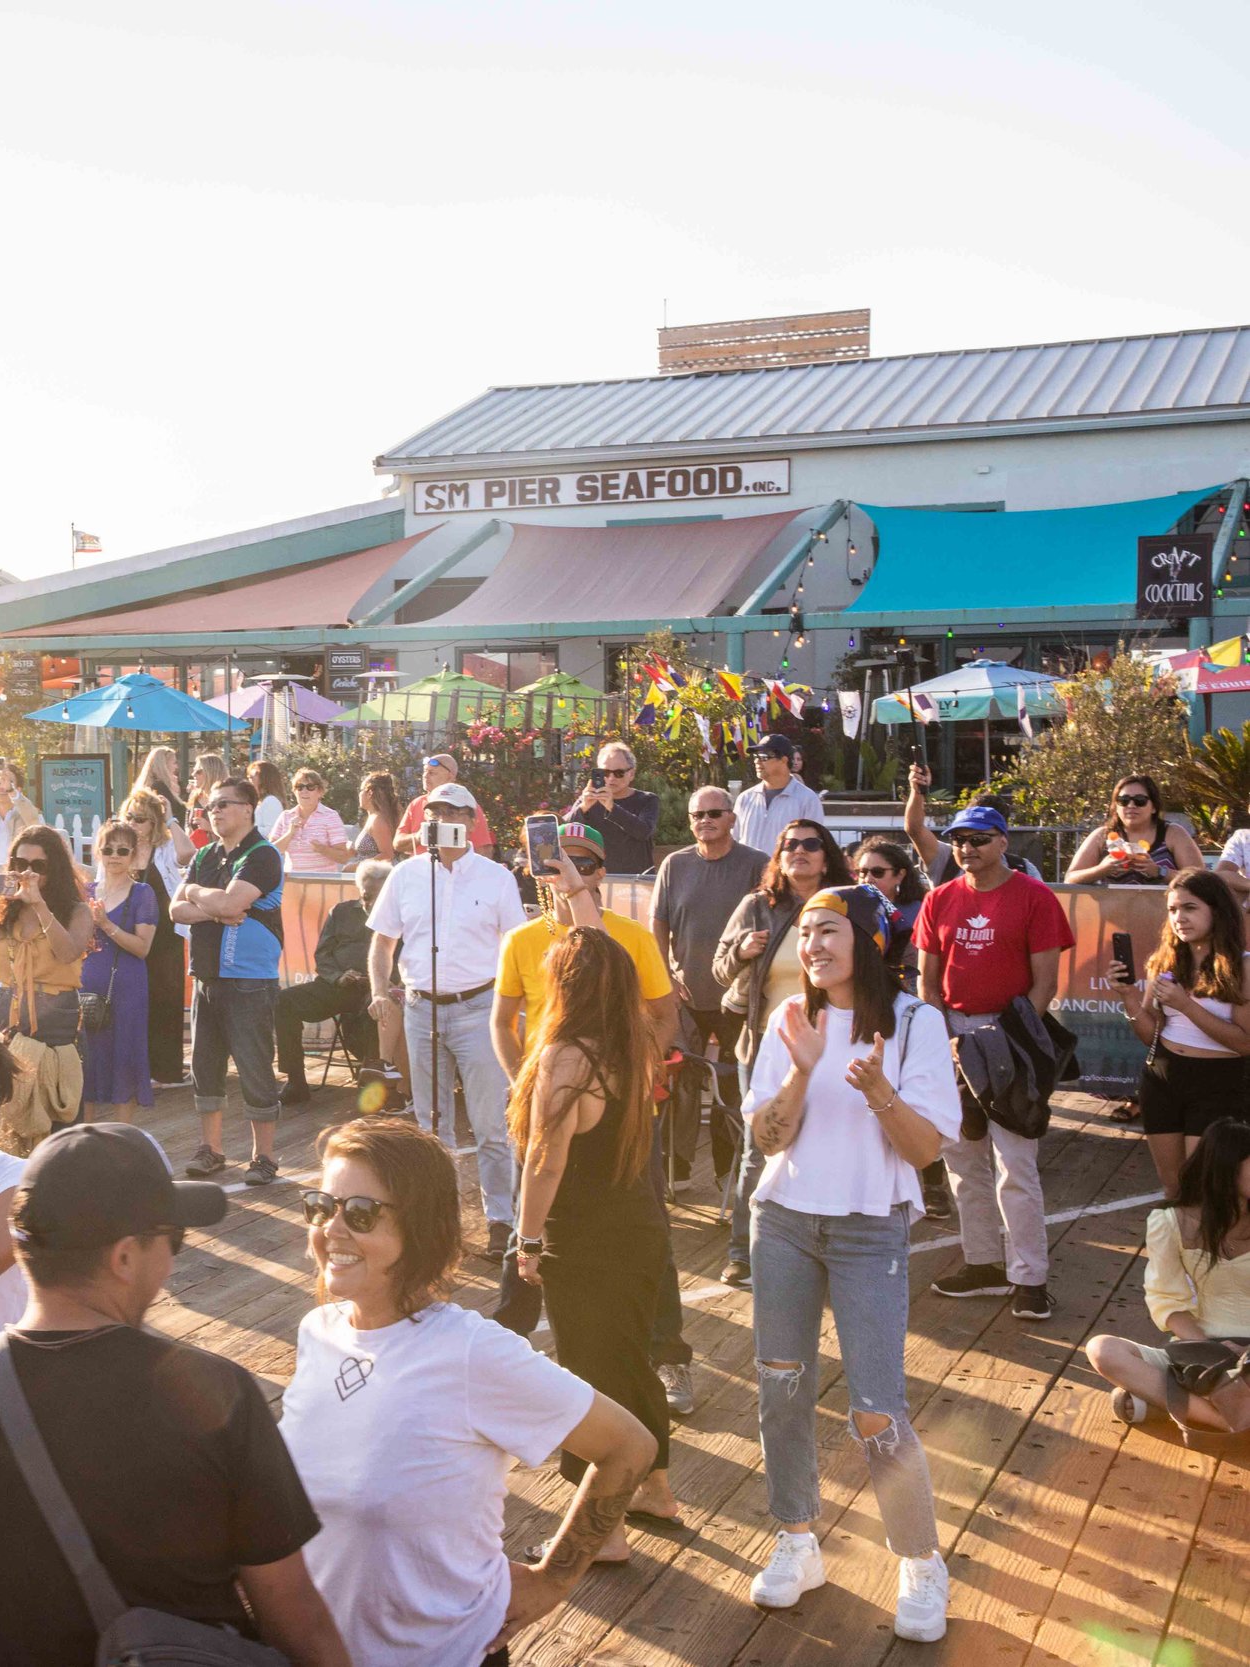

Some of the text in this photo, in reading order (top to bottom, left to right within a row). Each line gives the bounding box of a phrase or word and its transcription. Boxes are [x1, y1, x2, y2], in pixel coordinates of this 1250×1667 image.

[425, 482, 470, 511] SM
[484, 476, 561, 508] PIER
[1151, 546, 1202, 569] CRAFT
[1145, 582, 1204, 603] COCKTAILS
[332, 655, 361, 664] OYSTERS
[52, 767, 89, 777] ALBRIGHT
